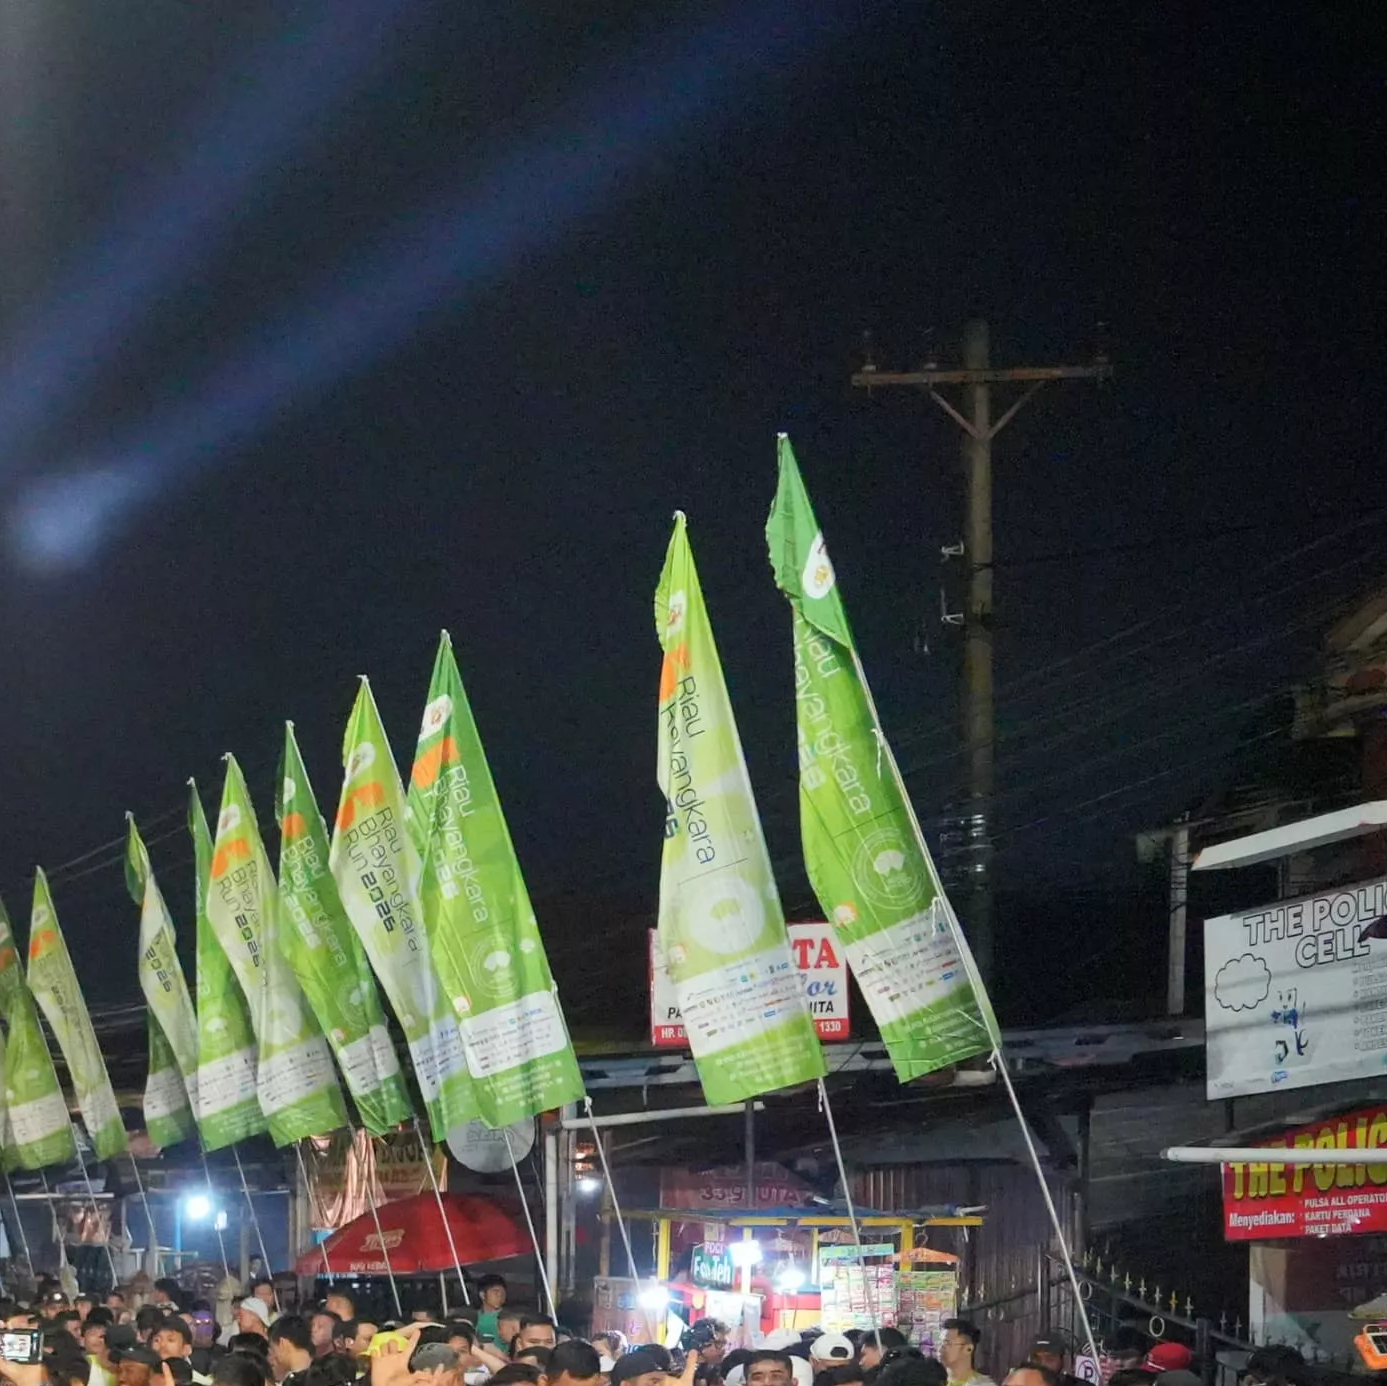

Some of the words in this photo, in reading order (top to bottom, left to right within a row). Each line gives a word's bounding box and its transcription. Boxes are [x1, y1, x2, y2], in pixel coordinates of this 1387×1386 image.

[677, 676, 705, 738] Riau
[361, 871, 396, 933] 2026
[1243, 904, 1304, 947] THE
[1312, 884, 1387, 931] POLI
[1295, 925, 1371, 968] CELL
[1229, 1210, 1296, 1231] Menyediakan:
[1330, 1196, 1346, 1207] ALL
[1305, 1223, 1330, 1235] PAKET
[1331, 1222, 1353, 1234] DATA
